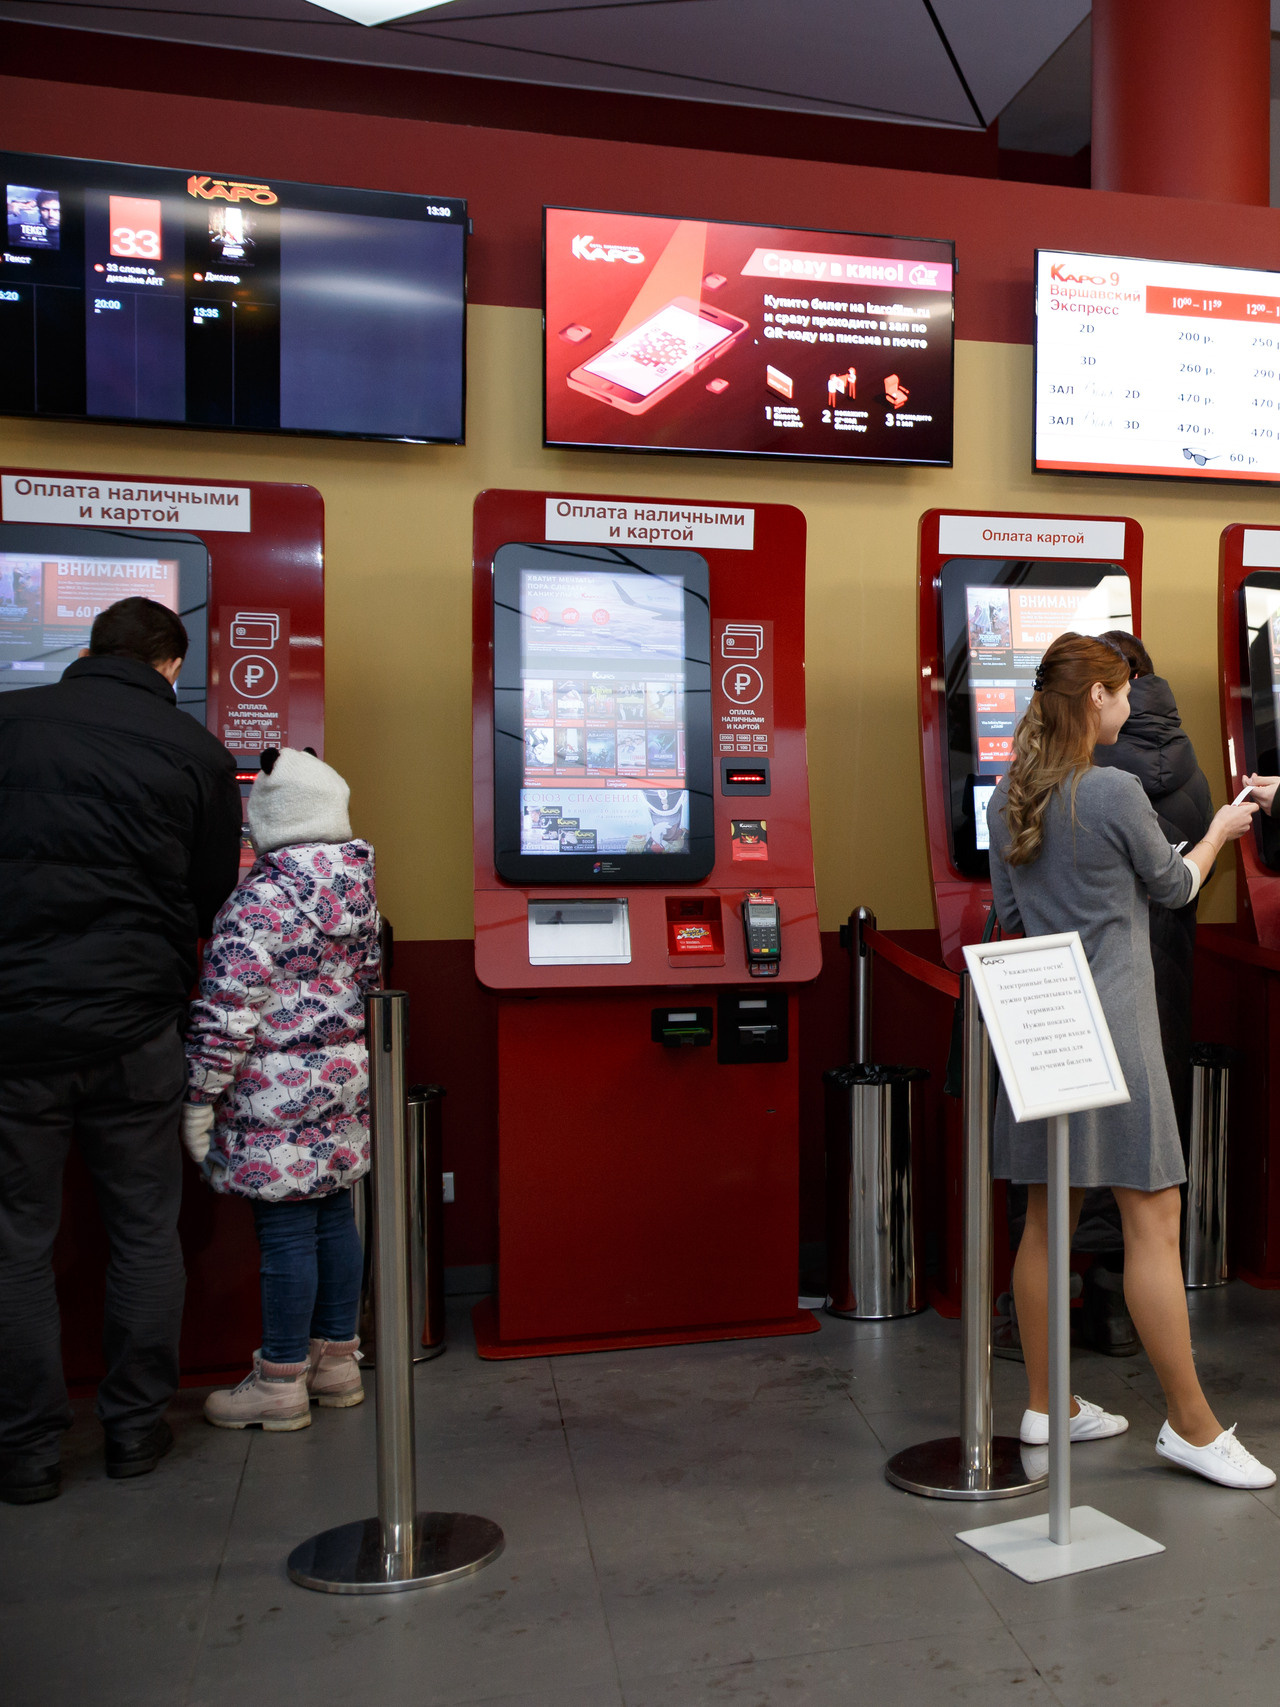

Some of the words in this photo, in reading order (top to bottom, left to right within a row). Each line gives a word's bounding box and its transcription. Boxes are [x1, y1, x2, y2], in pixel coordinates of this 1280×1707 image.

[187, 175, 278, 205] КАРО
[426, 205, 451, 217] 13:30
[112, 227, 160, 257] 33
[572, 234, 645, 264] КАРО
[3, 253, 32, 264] Текст
[106, 263, 118, 272] 33
[119, 265, 147, 275] слова
[763, 253, 826, 279] Сразу
[831, 263, 842, 277] в
[847, 264, 903, 282] кино!
[1050, 263, 1106, 285] КАРО
[1110, 272, 1120, 286] 9
[205, 272, 240, 284] Джокер
[1050, 284, 1141, 302] Варшавский
[94, 299, 121, 310] 20:00
[764, 294, 809, 309] Купите
[811, 298, 848, 313] билет
[850, 303, 864, 313] на
[1050, 299, 1119, 316] Экспресс
[193, 307, 219, 318] 13:35
[764, 313, 773, 322] и
[775, 314, 810, 328] сразу
[812, 316, 877, 330] проходите
[880, 321, 887, 331] в
[889, 322, 909, 332] зал
[912, 324, 927, 334] по
[1079, 324, 1095, 333] 2D
[764, 326, 818, 344] QR-коду
[819, 332, 835, 342] из
[836, 333, 881, 346] письма
[883, 336, 890, 346] в
[893, 337, 928, 349] почте
[1178, 332, 1200, 341] 200
[1252, 337, 1273, 347] 250
[1080, 356, 1096, 366] 3D
[1180, 364, 1201, 373] 260
[1253, 369, 1274, 379] 290
[1049, 385, 1074, 395] ЗАЛ
[1125, 390, 1140, 399] 2D
[1178, 394, 1200, 403] 470
[1252, 399, 1273, 408] 470
[765, 406, 772, 420] 1
[821, 409, 832, 423] 2
[885, 413, 894, 427] 3
[1049, 416, 1074, 426] ЗАЛ
[1124, 421, 1140, 430] 3D
[1178, 424, 1200, 433] 470
[1251, 429, 1273, 438] 470
[1230, 453, 1244, 463] 60
[14, 479, 100, 500] Оплата
[108, 488, 239, 506] наличными
[80, 505, 93, 519] и
[101, 505, 180, 524] картой
[556, 501, 628, 521] Оплата
[634, 509, 745, 526] наличными
[609, 526, 620, 537] и
[627, 525, 694, 543] картой
[982, 529, 1033, 545] Оплата
[1037, 531, 1085, 548] картой
[57, 561, 169, 579] ВНИМАНИЕ!
[76, 606, 91, 618] 60
[523, 793, 560, 802] СОЮЗ
[568, 794, 638, 803] СПАСЕНИЯ
